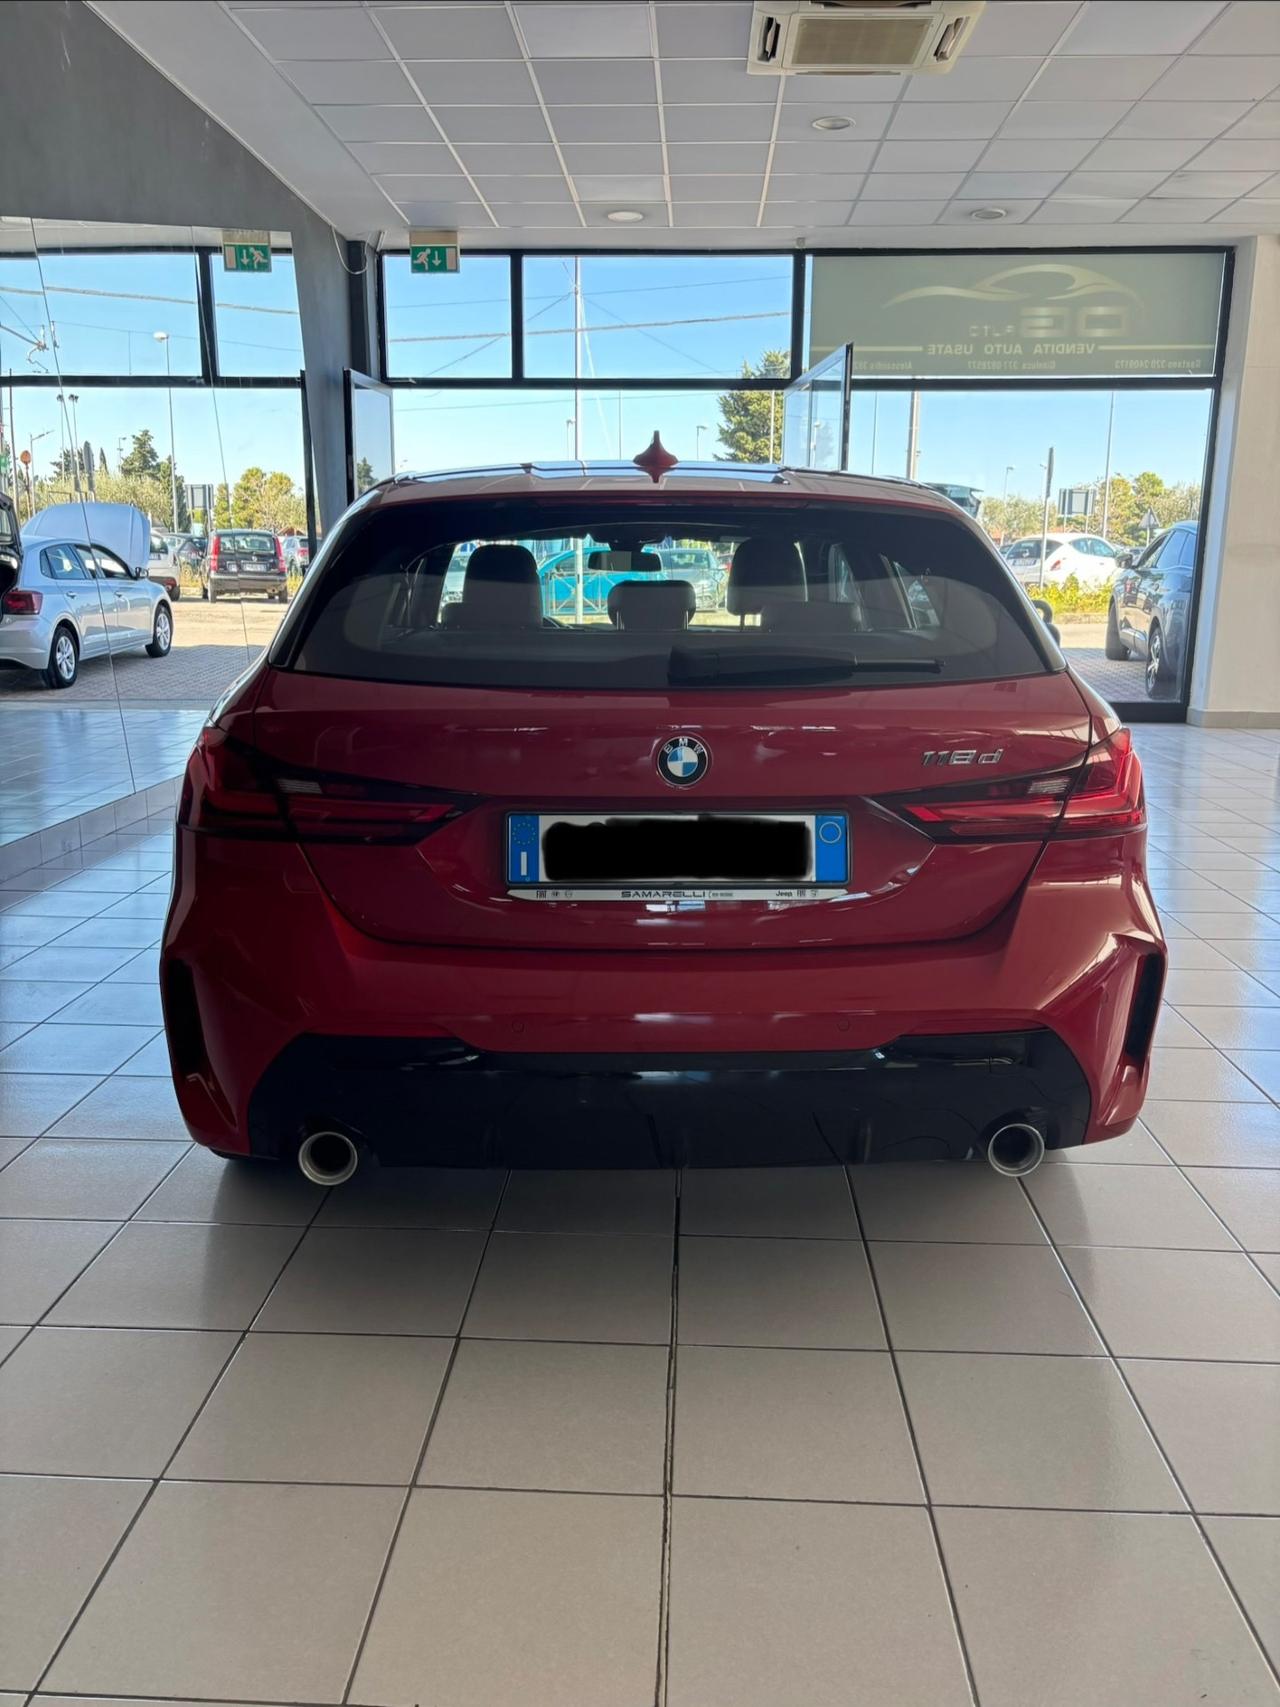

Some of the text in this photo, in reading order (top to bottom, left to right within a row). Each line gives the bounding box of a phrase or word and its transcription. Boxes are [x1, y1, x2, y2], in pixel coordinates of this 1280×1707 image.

[664, 737, 704, 755] BMW
[621, 890, 706, 898] SAMARELLI
[775, 890, 793, 898] Jeep
